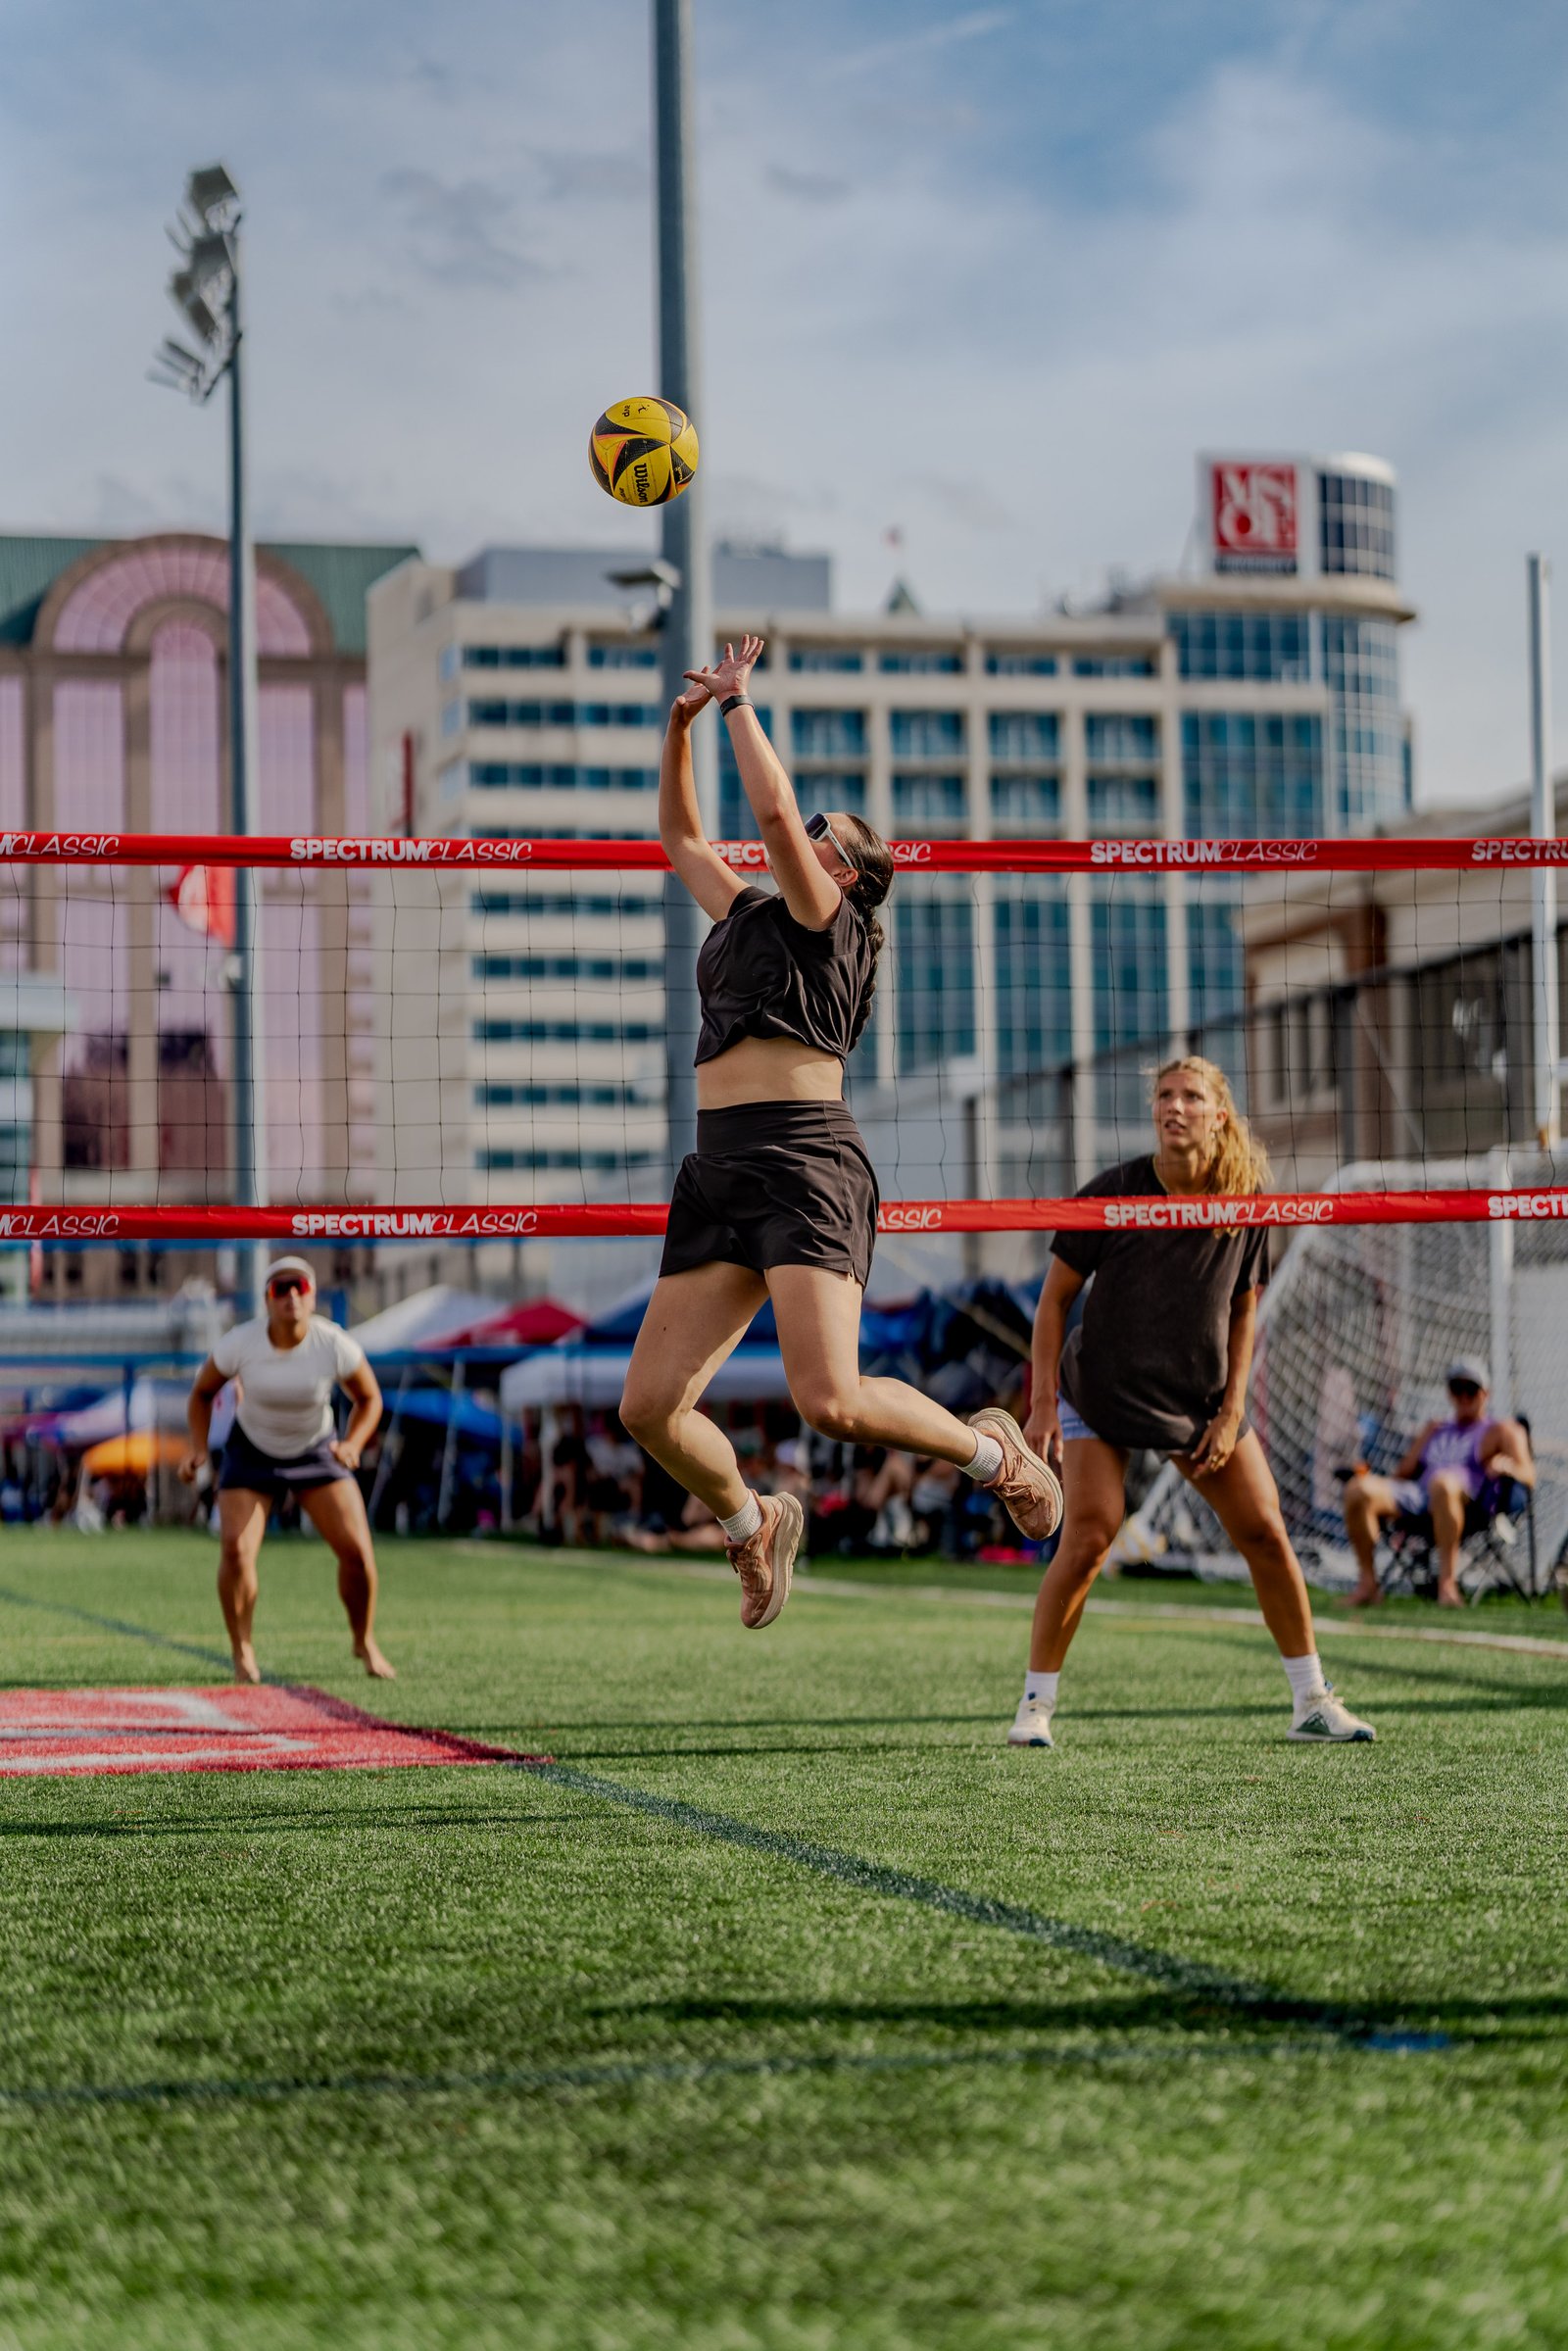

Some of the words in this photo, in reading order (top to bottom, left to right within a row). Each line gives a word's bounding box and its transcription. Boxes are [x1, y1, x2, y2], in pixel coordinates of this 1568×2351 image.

[634, 463, 650, 503] Wilson
[11, 834, 120, 856] CLASSIC
[290, 839, 428, 861] SPECTRUM
[426, 841, 532, 861] CLASSIC
[1091, 841, 1221, 863] SPECTRUM
[1219, 841, 1318, 862] CLASSIC
[1103, 1201, 1235, 1226] SPECTRUM
[1233, 1200, 1334, 1223] CLASSIC
[1488, 1194, 1568, 1218] SPECT
[10, 1214, 120, 1236] CLASSIC
[291, 1213, 432, 1236] SPECTRUM
[430, 1212, 537, 1235] CLASSIC
[877, 1207, 942, 1230] ASSIC
